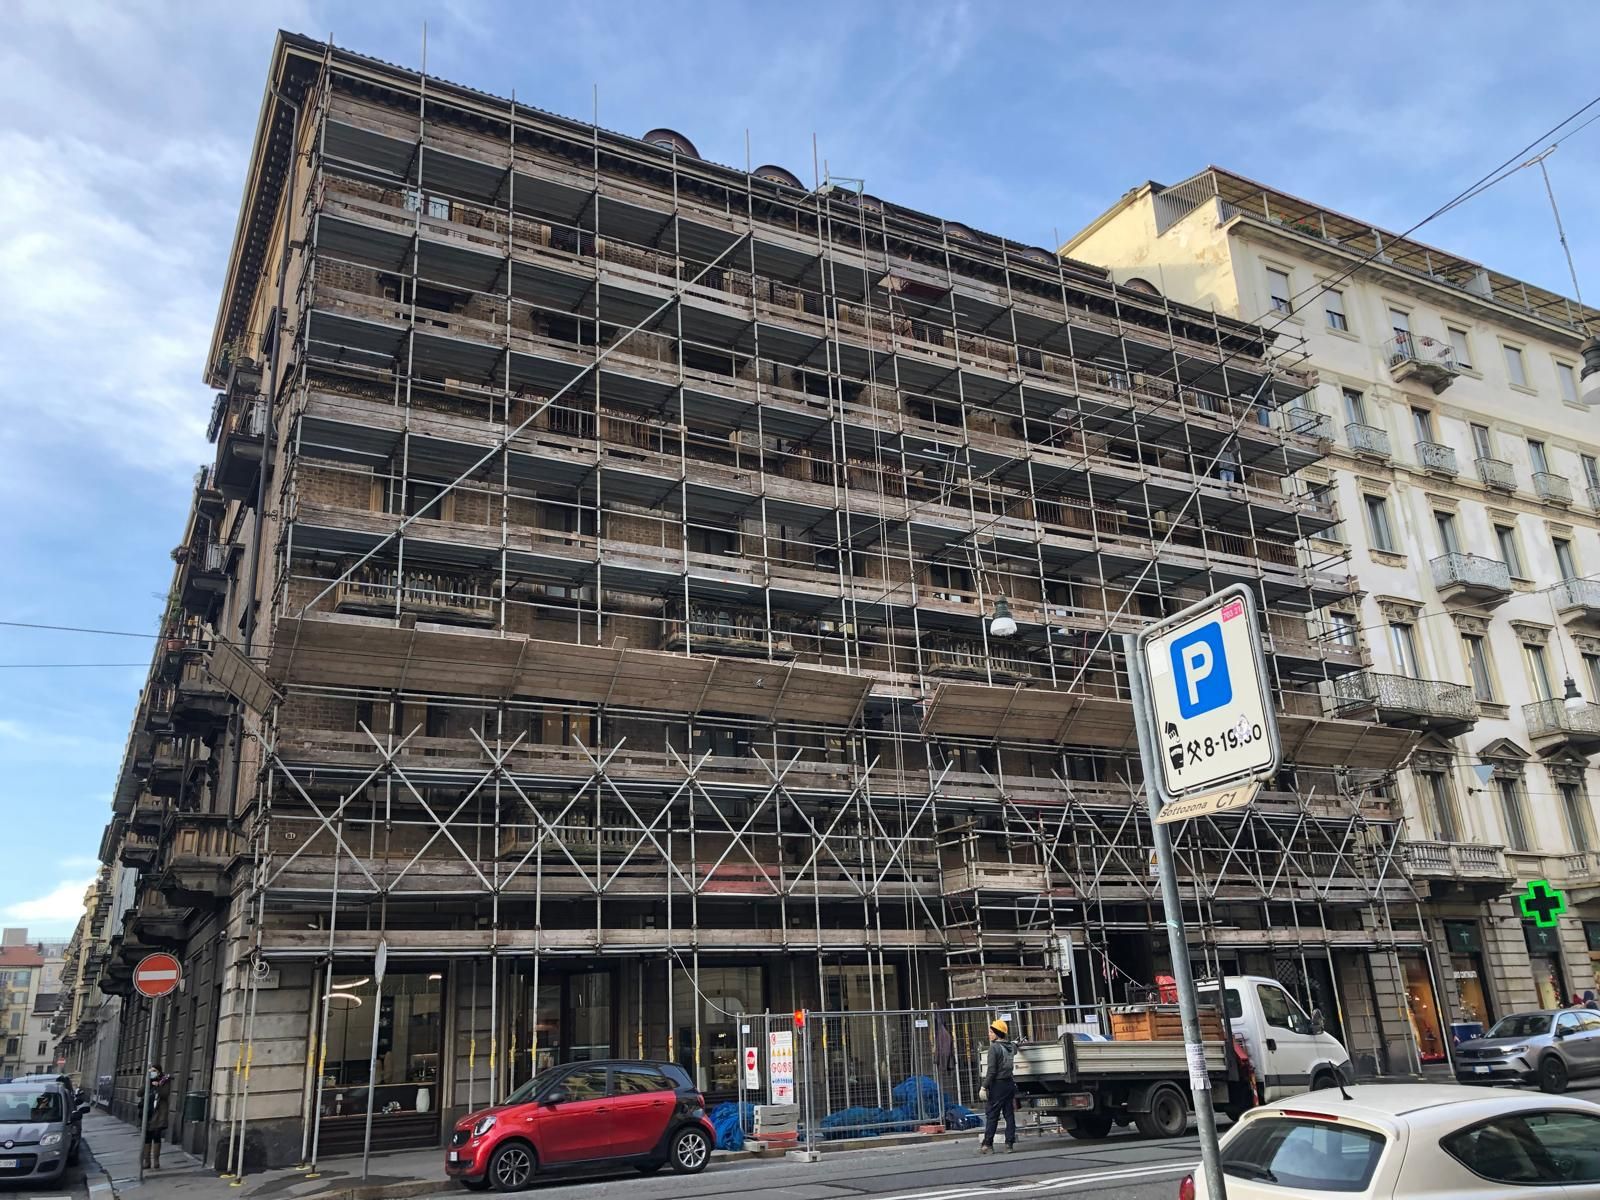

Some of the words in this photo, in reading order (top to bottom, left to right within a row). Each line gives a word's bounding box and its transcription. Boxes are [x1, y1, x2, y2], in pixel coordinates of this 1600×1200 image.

[1182, 640, 1214, 706] P
[1159, 802, 1208, 818] Sottozona
[1216, 791, 1238, 809] C1
